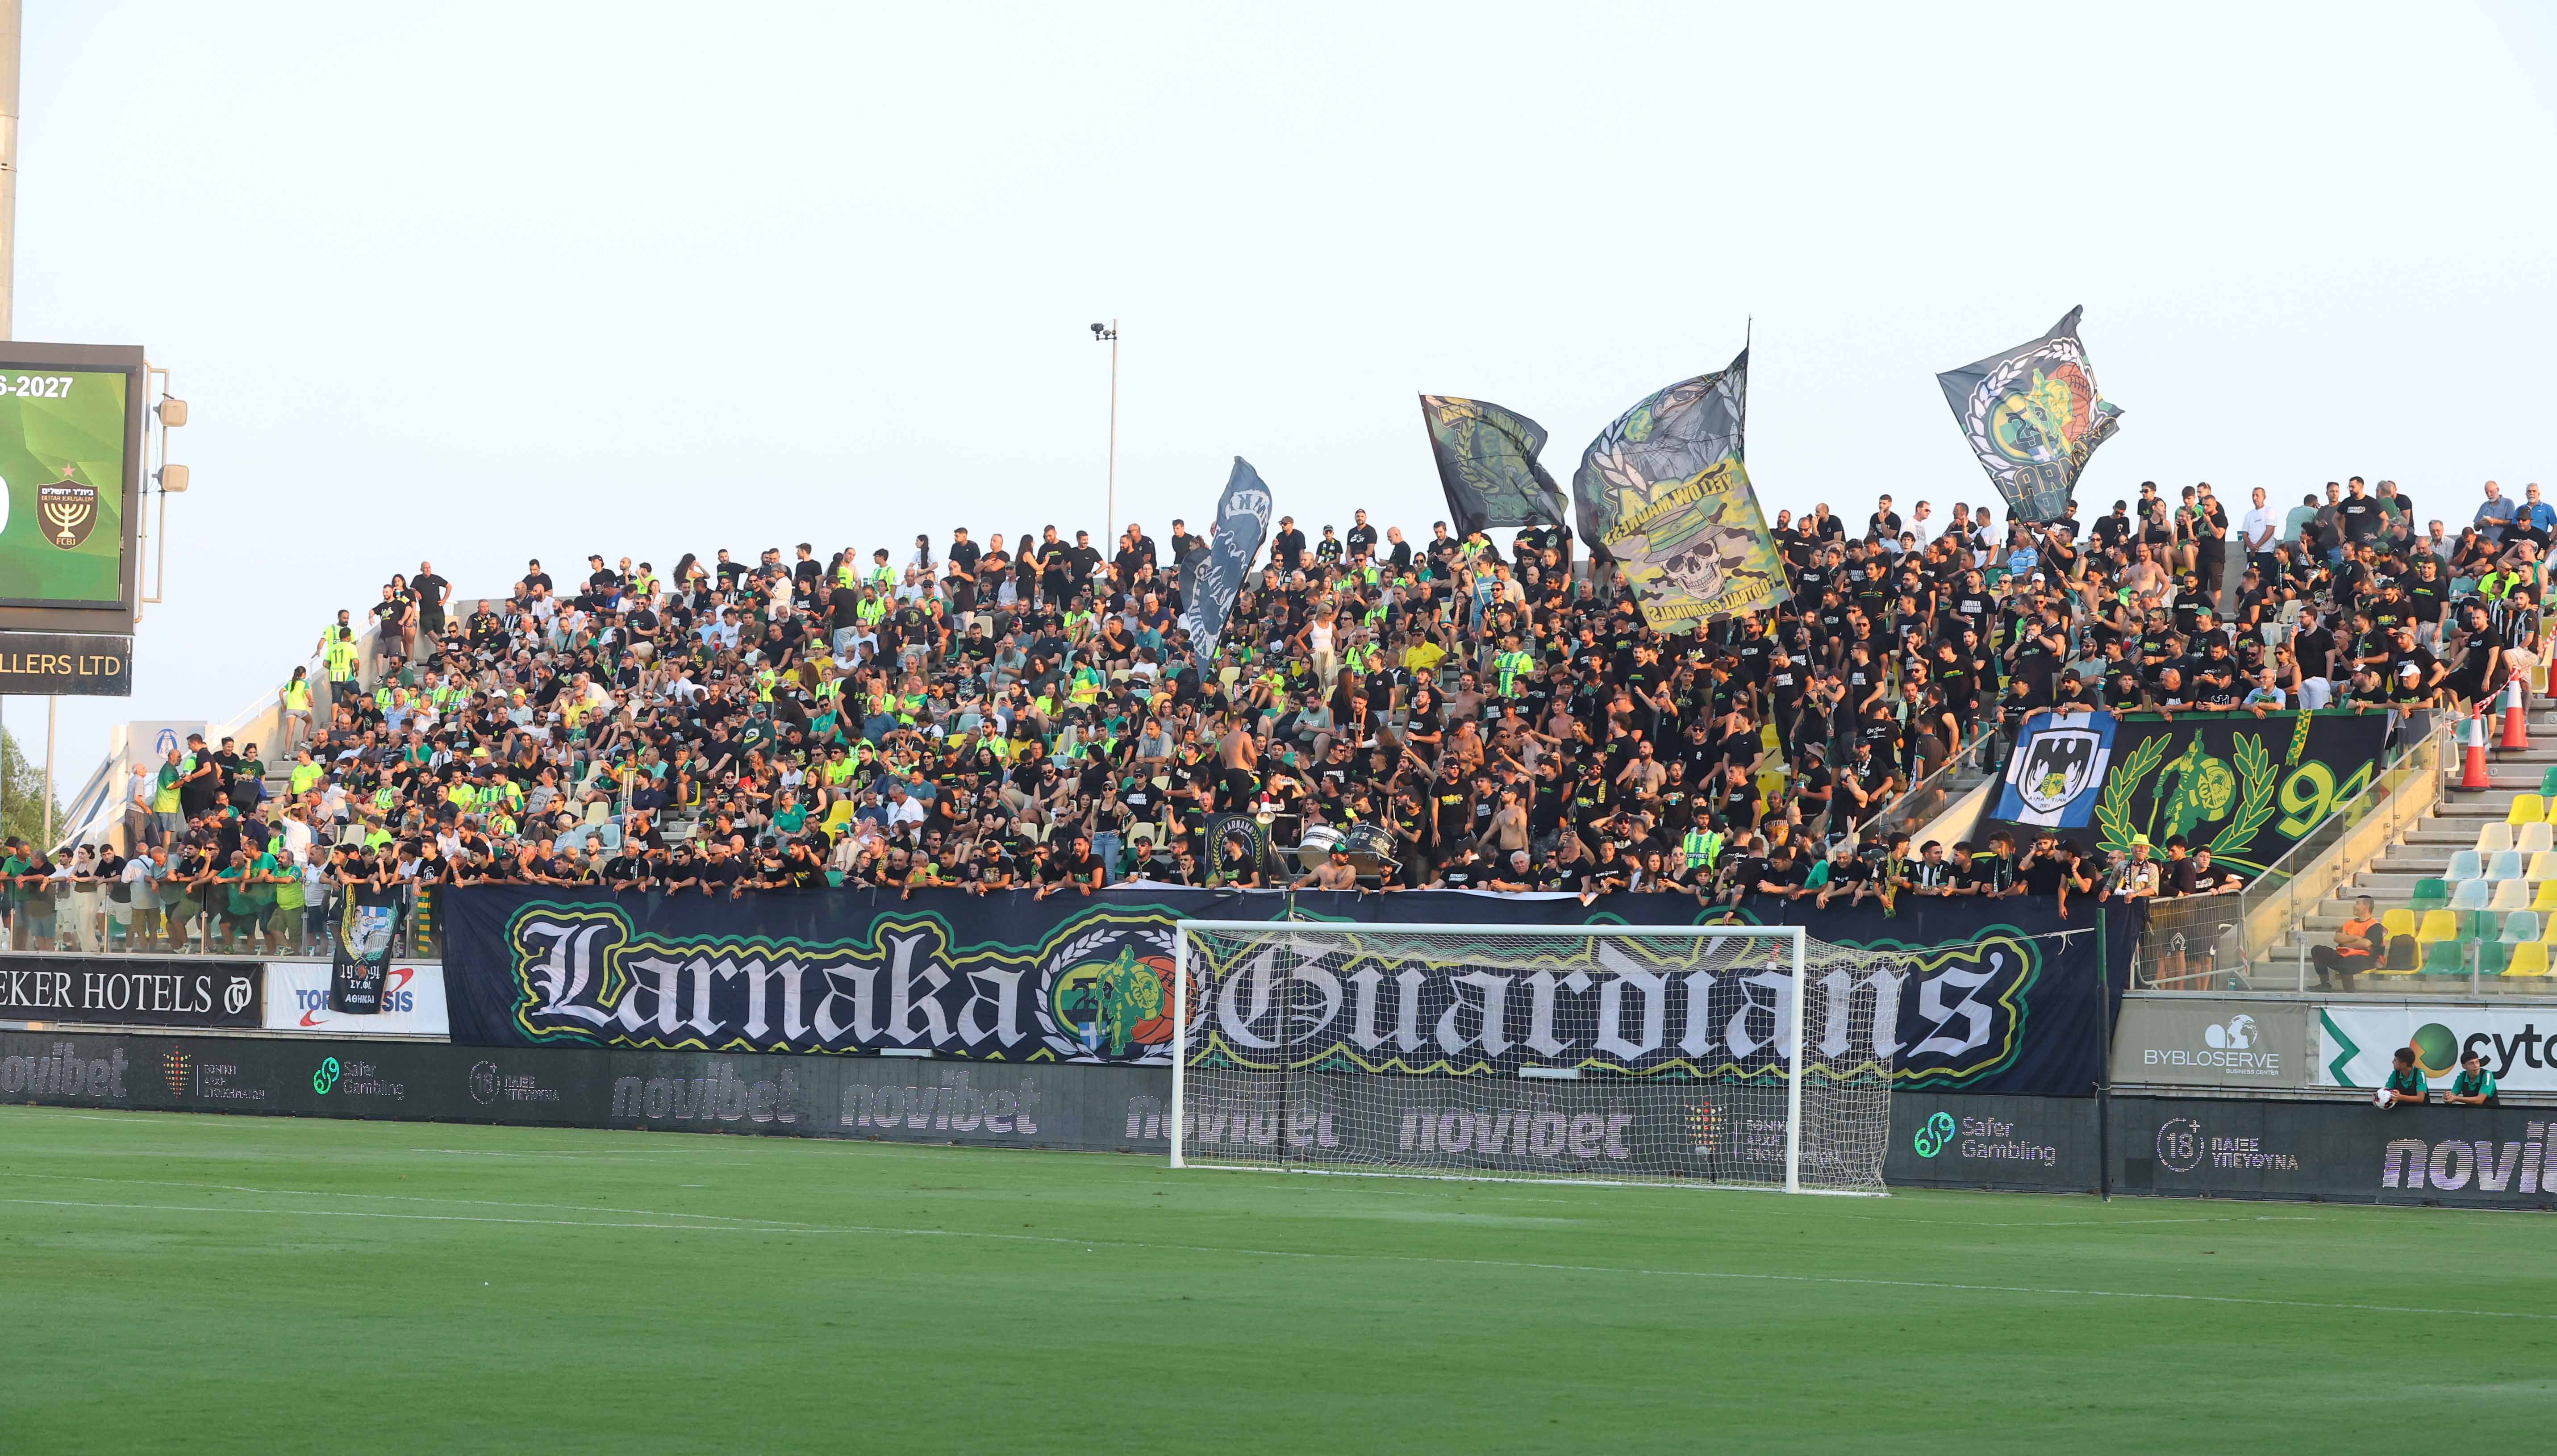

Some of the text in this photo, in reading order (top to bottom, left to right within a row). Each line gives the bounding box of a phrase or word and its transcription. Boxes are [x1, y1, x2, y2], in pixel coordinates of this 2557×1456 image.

[56, 538, 76, 546] FCBJ
[0, 653, 121, 676] LLERS LTD
[333, 649, 344, 663] 11
[1223, 820, 1253, 834] LARNAKA
[82, 973, 212, 1013] HOTELS
[345, 994, 375, 1004] ΑΘΗΝΑΙ
[523, 922, 2004, 1061] Larnaka Guardians
[2144, 1050, 2279, 1068] BYBLOSERVE
[612, 1061, 799, 1124] novibet
[841, 1070, 1042, 1134] novibet
[1399, 1090, 1632, 1159] novibet
[1962, 1117, 2014, 1137] Safer
[1961, 1139, 2056, 1168] Gambling
